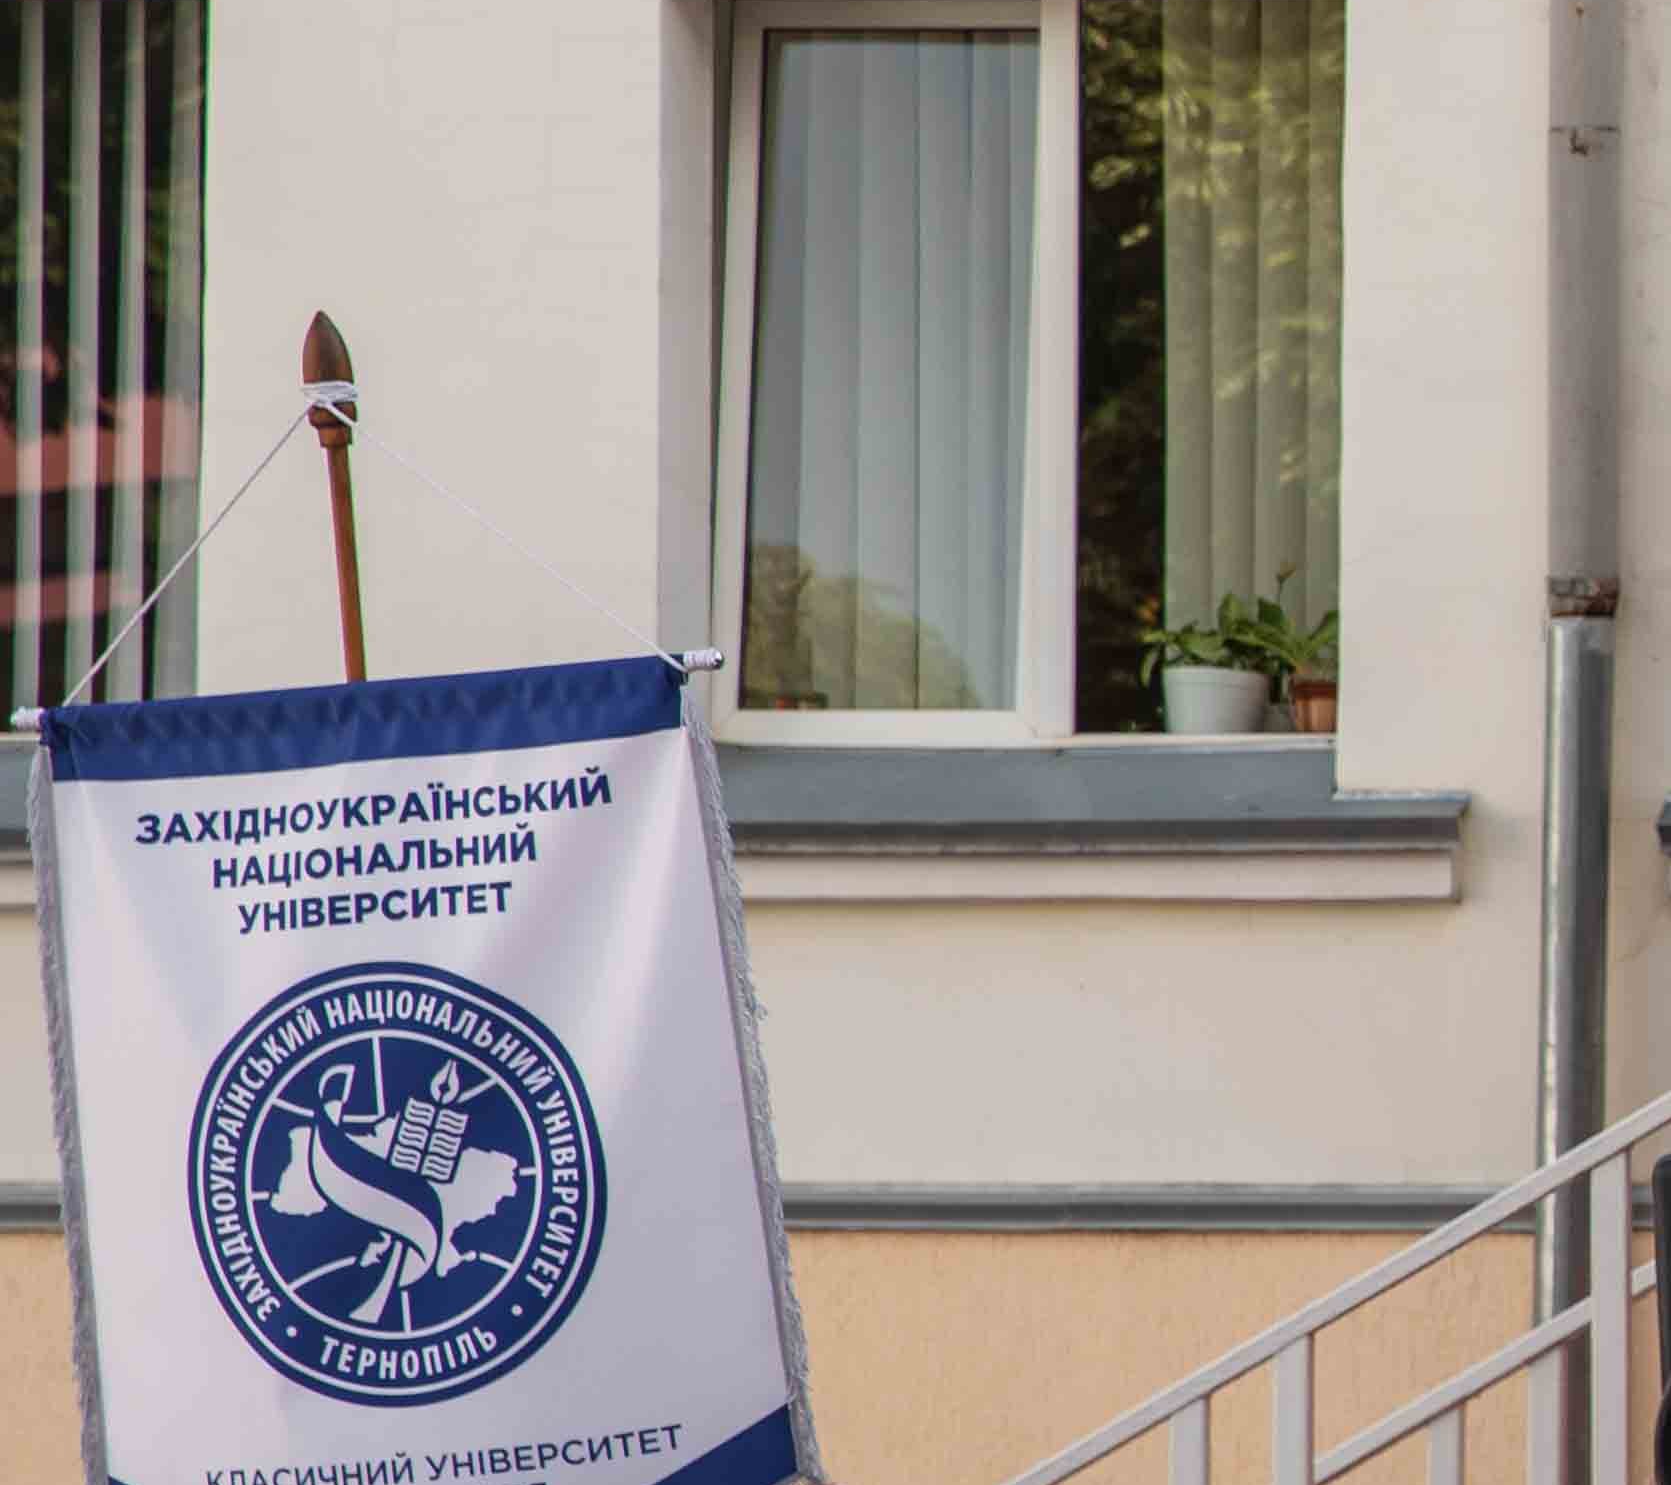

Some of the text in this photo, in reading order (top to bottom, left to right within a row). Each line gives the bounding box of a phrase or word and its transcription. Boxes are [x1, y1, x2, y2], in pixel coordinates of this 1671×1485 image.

[135, 766, 612, 845] ЗАХІДНОУКРАЇНСЬКИЙ
[212, 822, 538, 889] НАЦІОНАЛЬНИЙ
[238, 881, 513, 935] УНІВЕРСИТЕТ
[209, 989, 580, 1323] ЗАХІДНОУКРАЇНСЬКИЙ НАЦІОНАЛЬНИЙ УНІВЕРСИТЕТ
[319, 1325, 498, 1381] ТЕРНОПІЛЬ
[425, 1423, 683, 1482] УНІВЕРСИТЕТ
